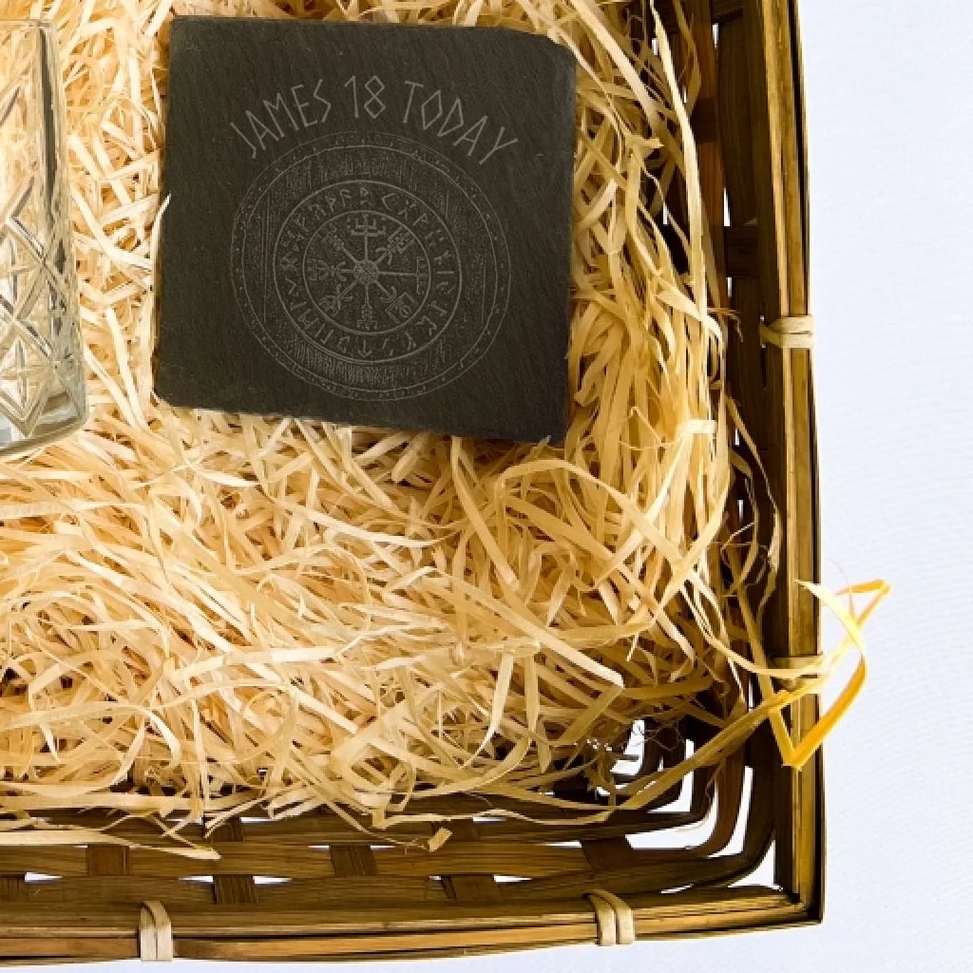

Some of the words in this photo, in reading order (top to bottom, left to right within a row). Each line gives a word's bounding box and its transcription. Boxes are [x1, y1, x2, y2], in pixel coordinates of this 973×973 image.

[230, 78, 332, 159] JAMES
[343, 74, 386, 120] 18
[402, 79, 519, 165] TODAY
